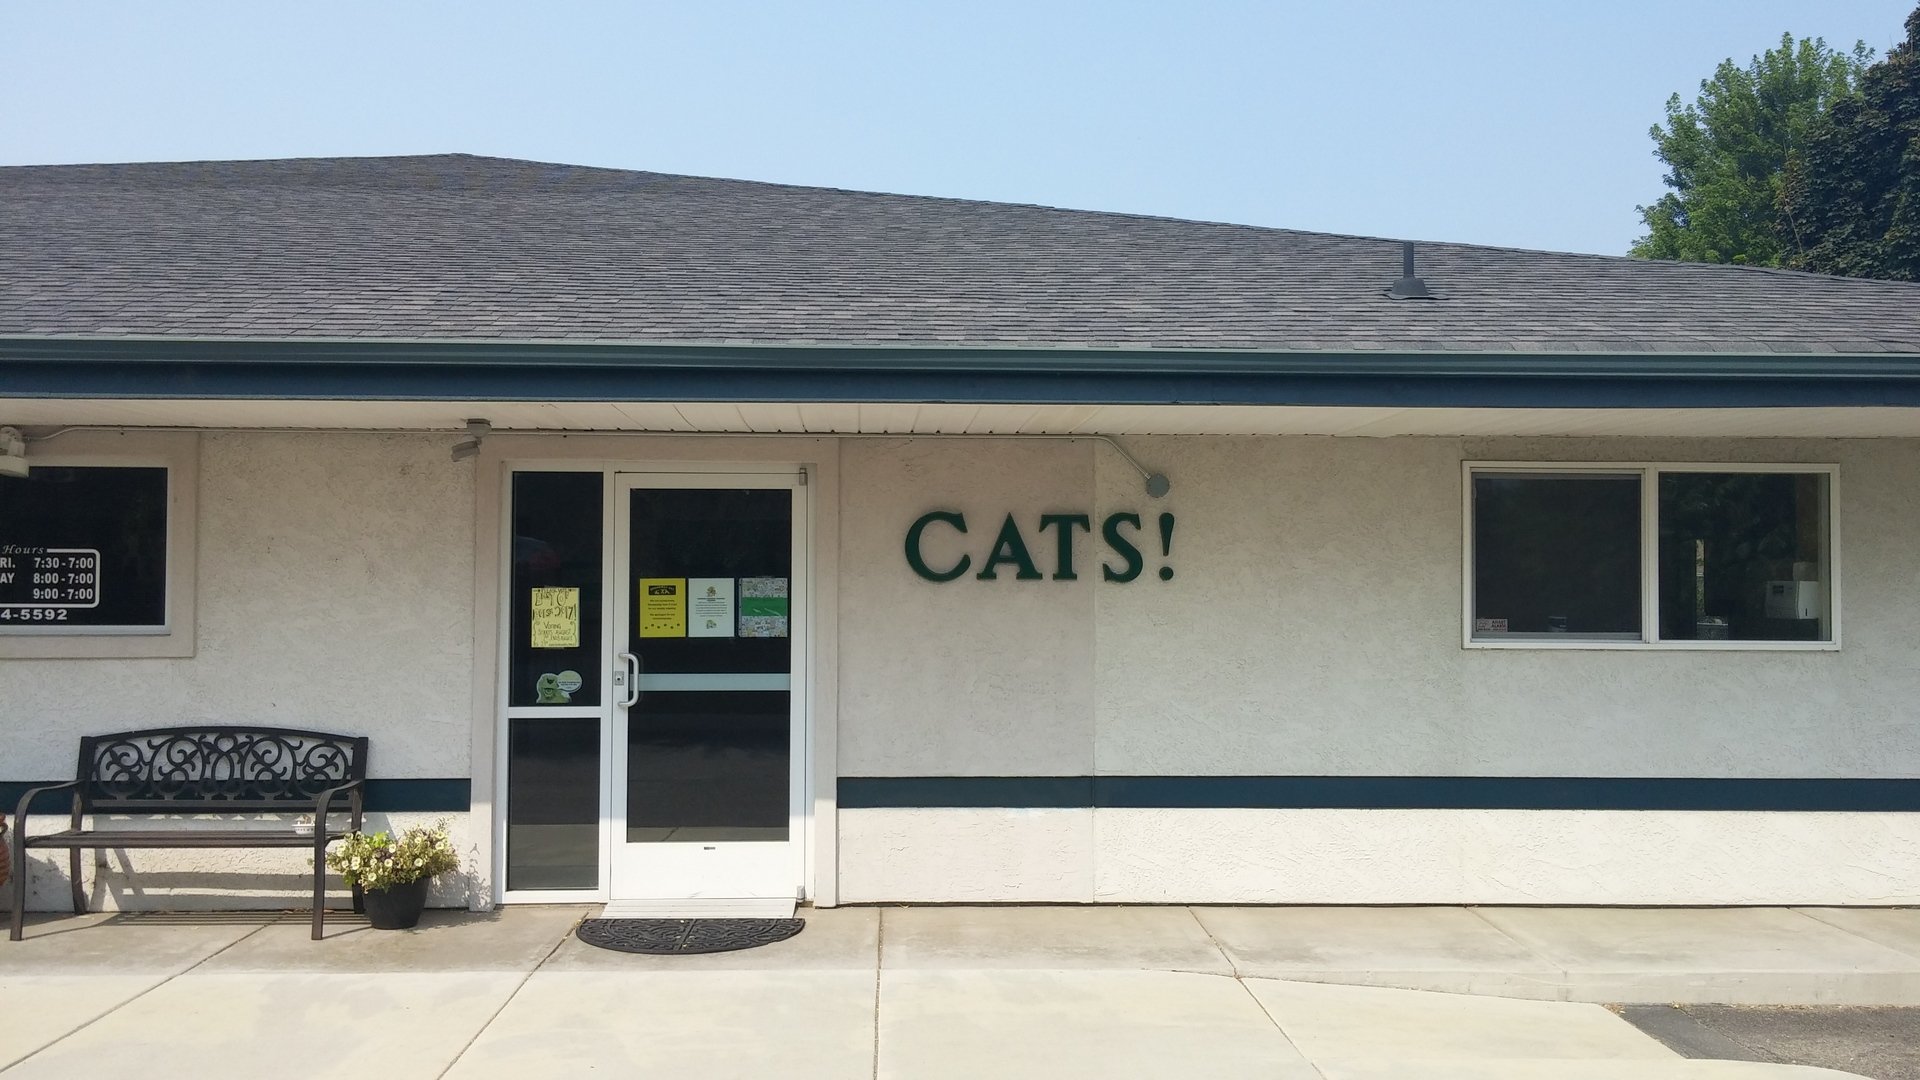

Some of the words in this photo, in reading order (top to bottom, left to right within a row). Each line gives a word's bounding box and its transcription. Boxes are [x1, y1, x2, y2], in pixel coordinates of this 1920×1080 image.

[3, 544, 45, 555] Hours
[904, 510, 1176, 583] CATS!
[0, 608, 68, 620] 4-5592
